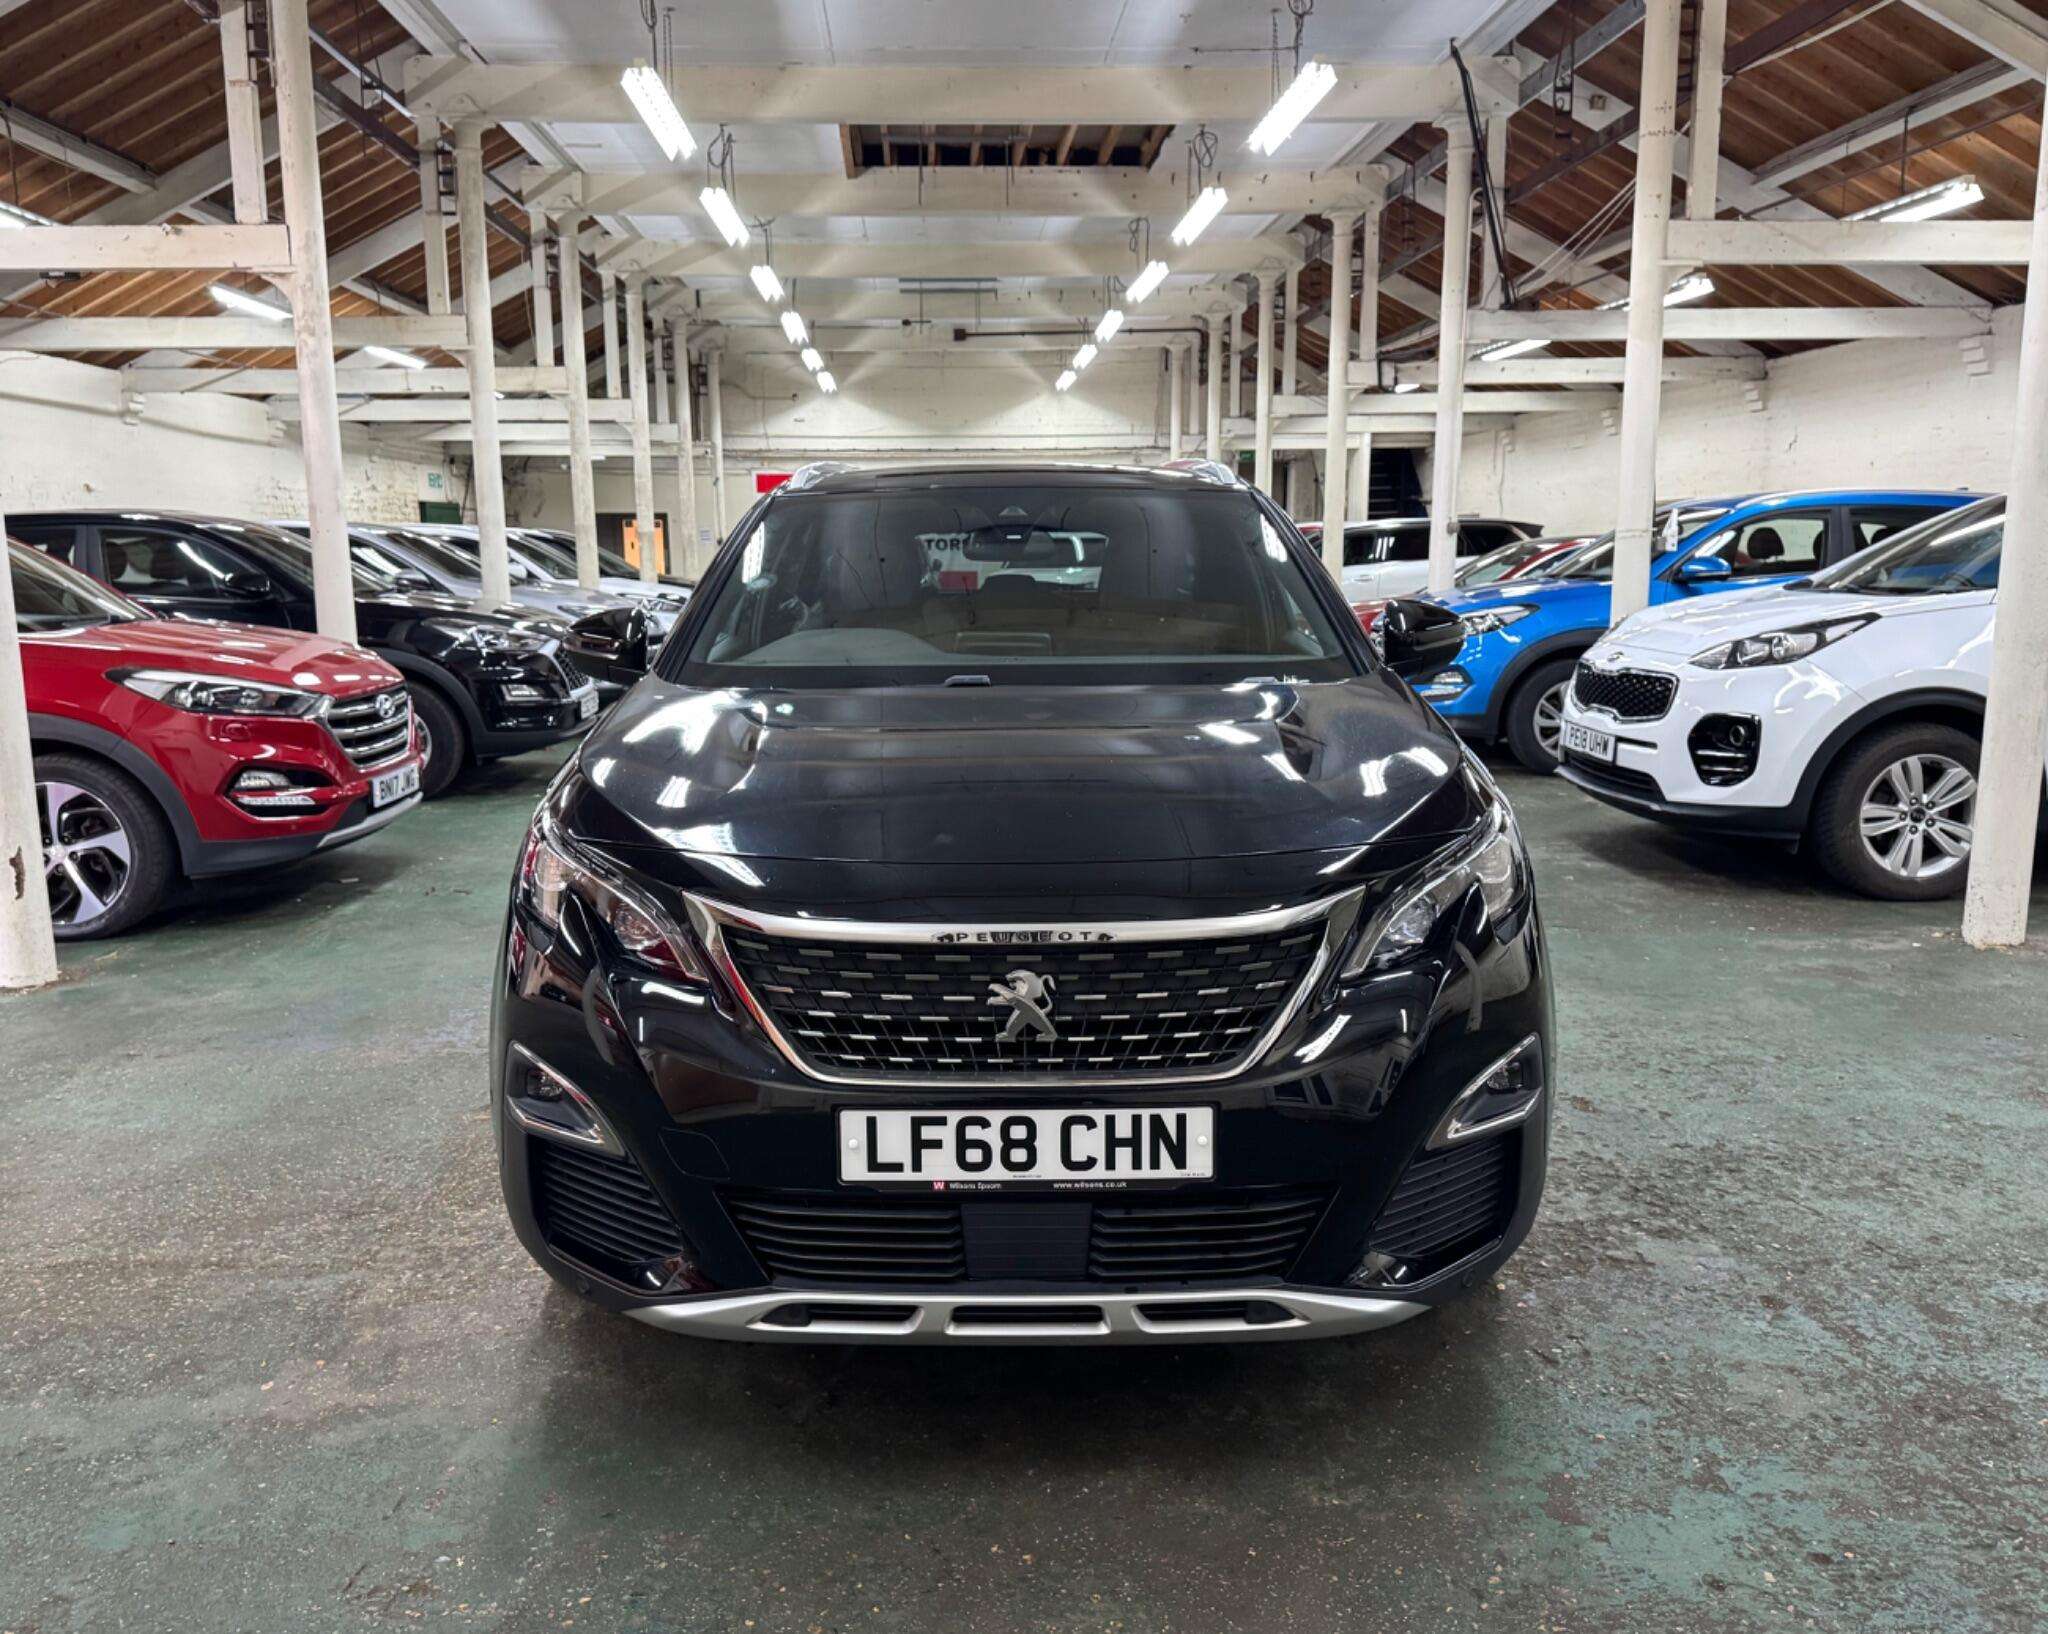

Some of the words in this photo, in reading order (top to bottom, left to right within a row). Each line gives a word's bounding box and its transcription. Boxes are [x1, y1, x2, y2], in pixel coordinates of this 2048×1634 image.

[955, 930, 1093, 943] PEUGEOT
[866, 1115, 1037, 1173] LF68
[1060, 1113, 1187, 1172] CHN
